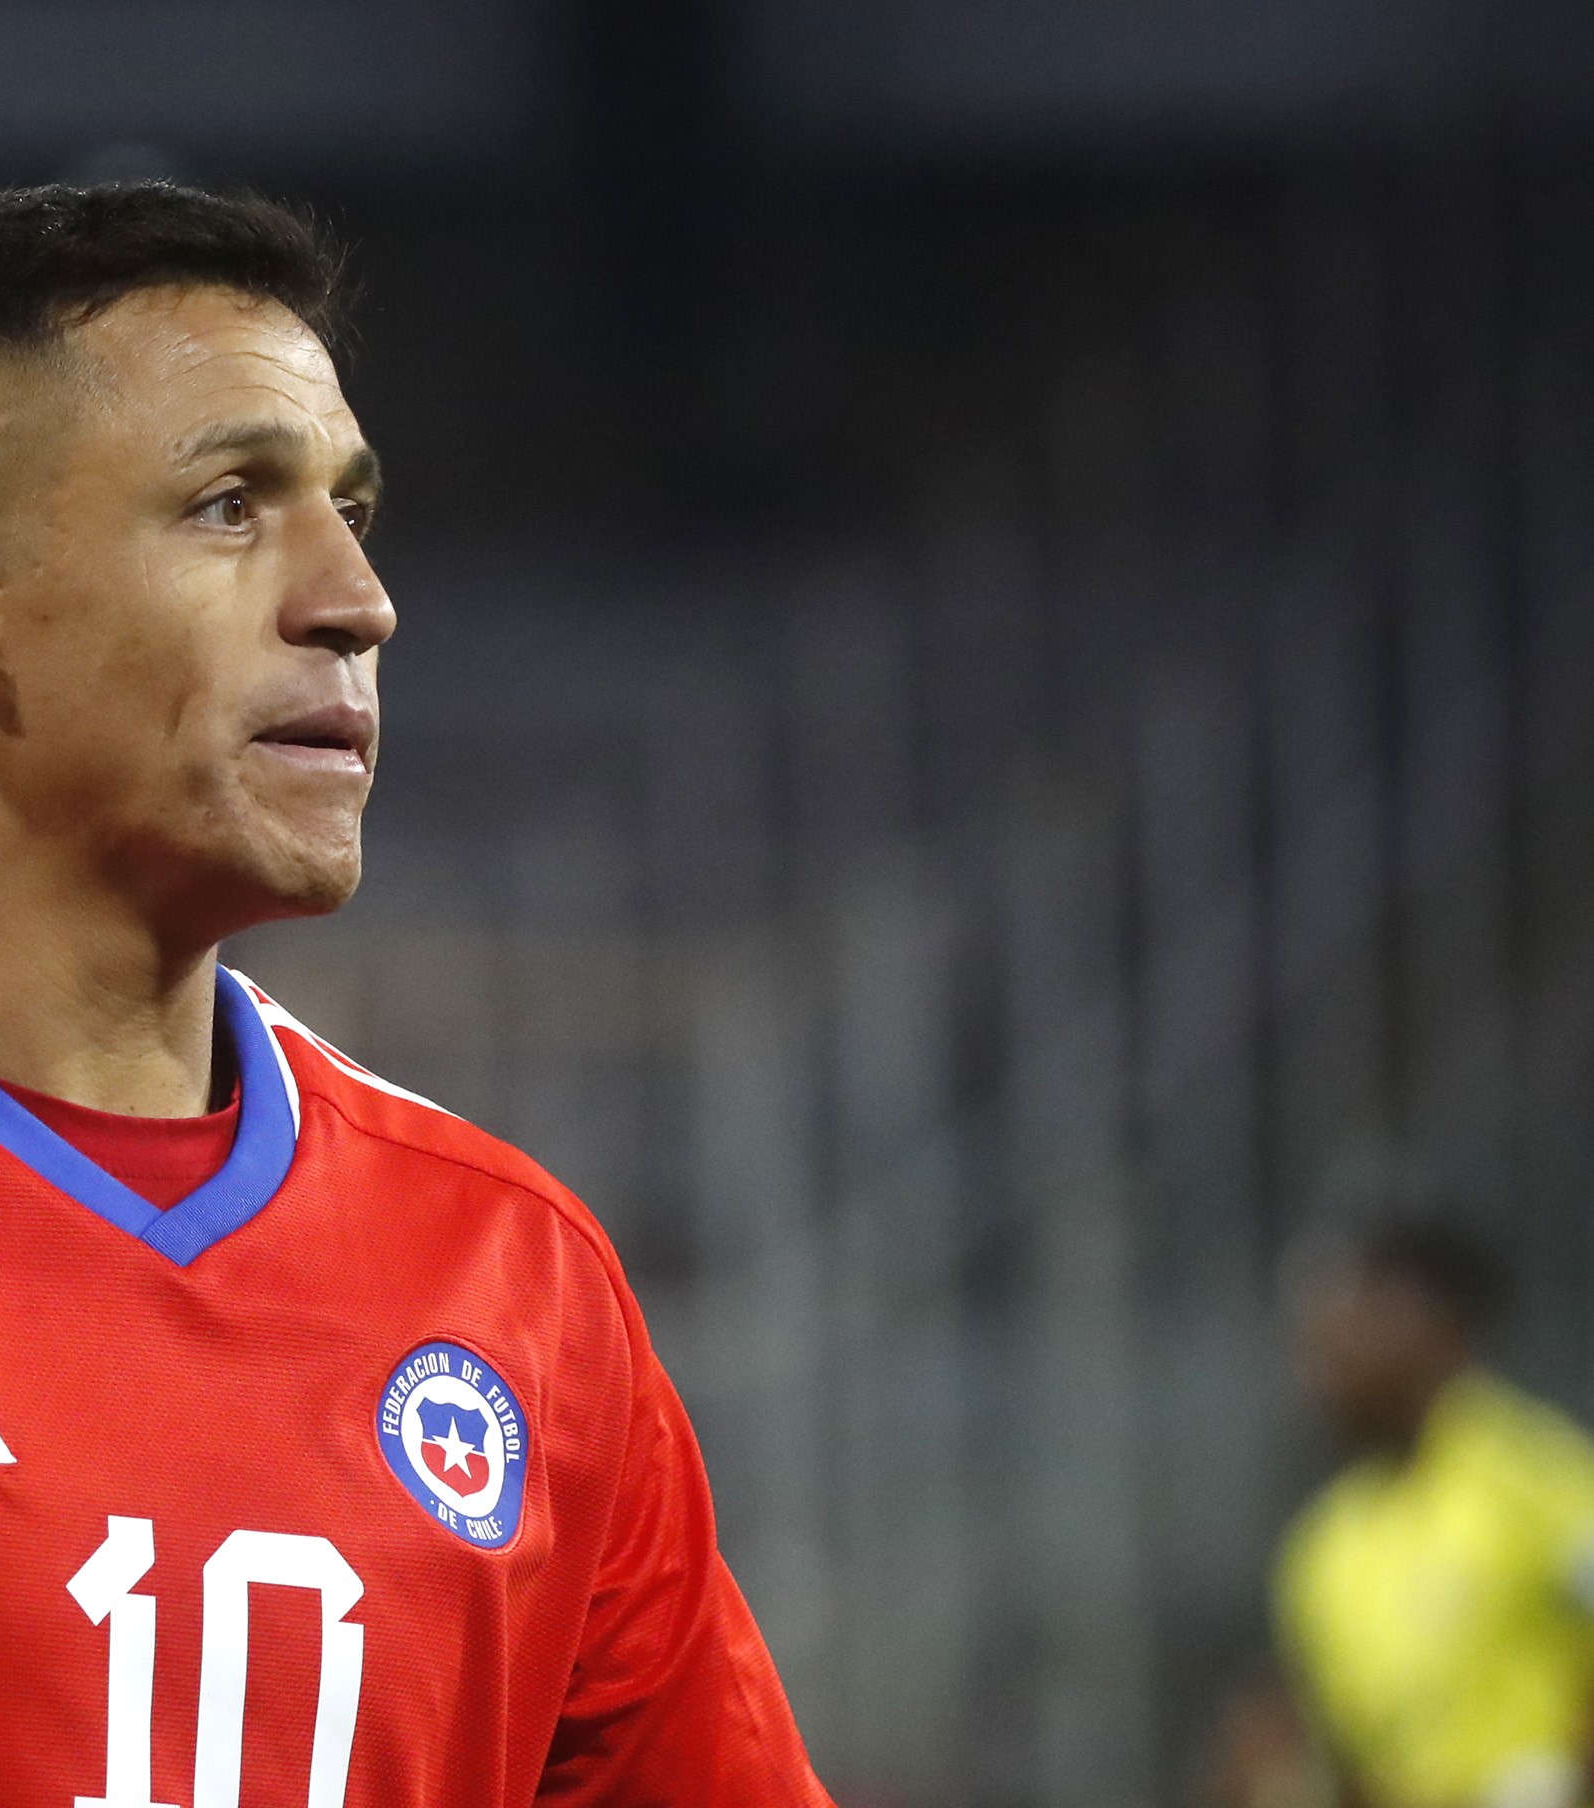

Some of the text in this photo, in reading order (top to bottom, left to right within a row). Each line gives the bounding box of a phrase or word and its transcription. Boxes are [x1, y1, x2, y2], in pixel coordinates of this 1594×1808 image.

[382, 1352, 521, 1464] FEDERACION DE FUTBOL
[437, 1502, 503, 1541] DE CHILE
[65, 1514, 365, 1808] 10
